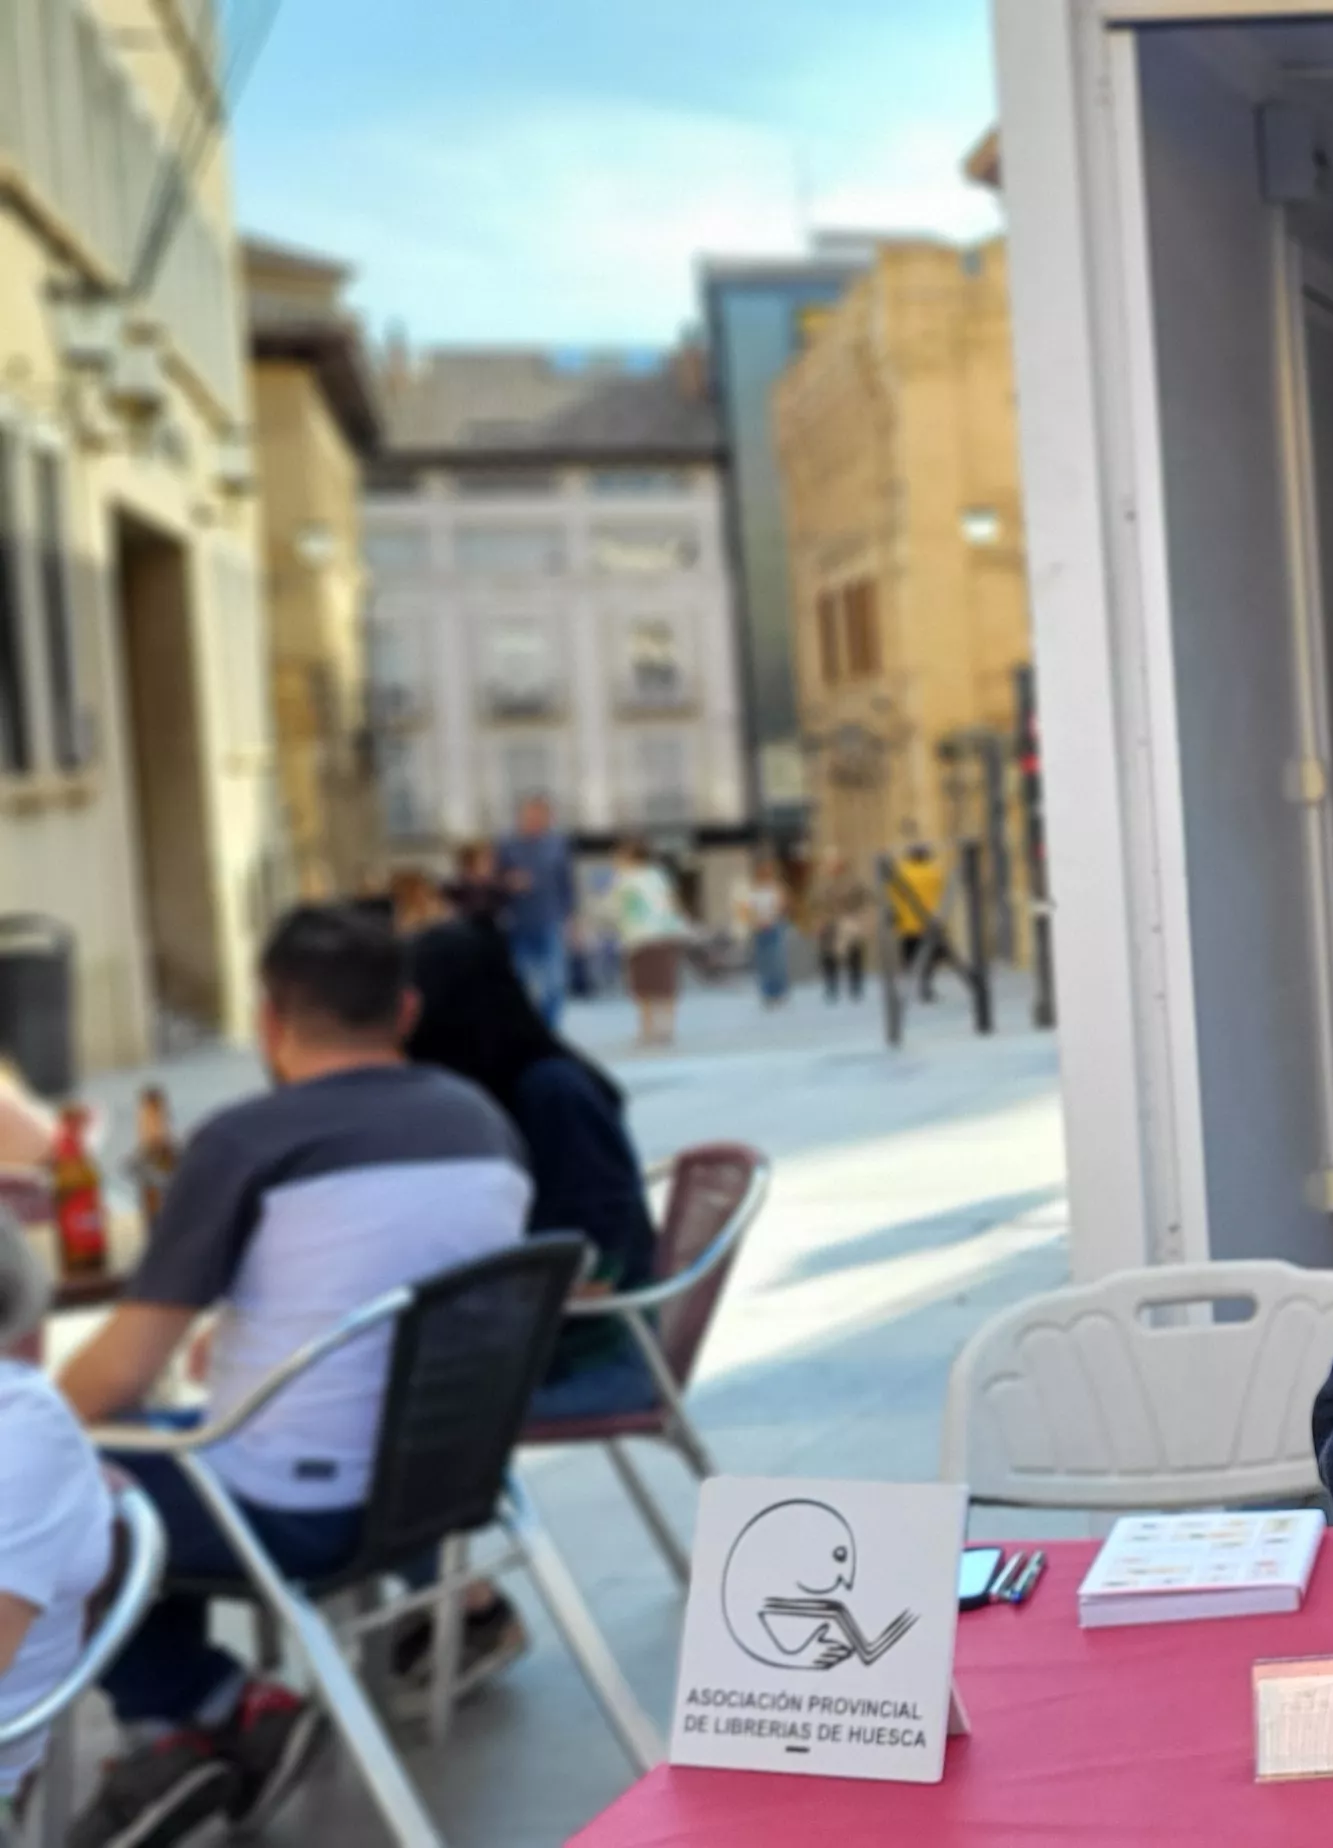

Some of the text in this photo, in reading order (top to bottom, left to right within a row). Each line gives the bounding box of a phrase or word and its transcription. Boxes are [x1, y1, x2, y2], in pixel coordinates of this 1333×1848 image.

[686, 1689, 923, 1720] ASOCIACIÓN PROVINCIAL
[684, 1714, 709, 1733] DE
[817, 1723, 841, 1743] DE
[849, 1726, 927, 1748] HUESCA
